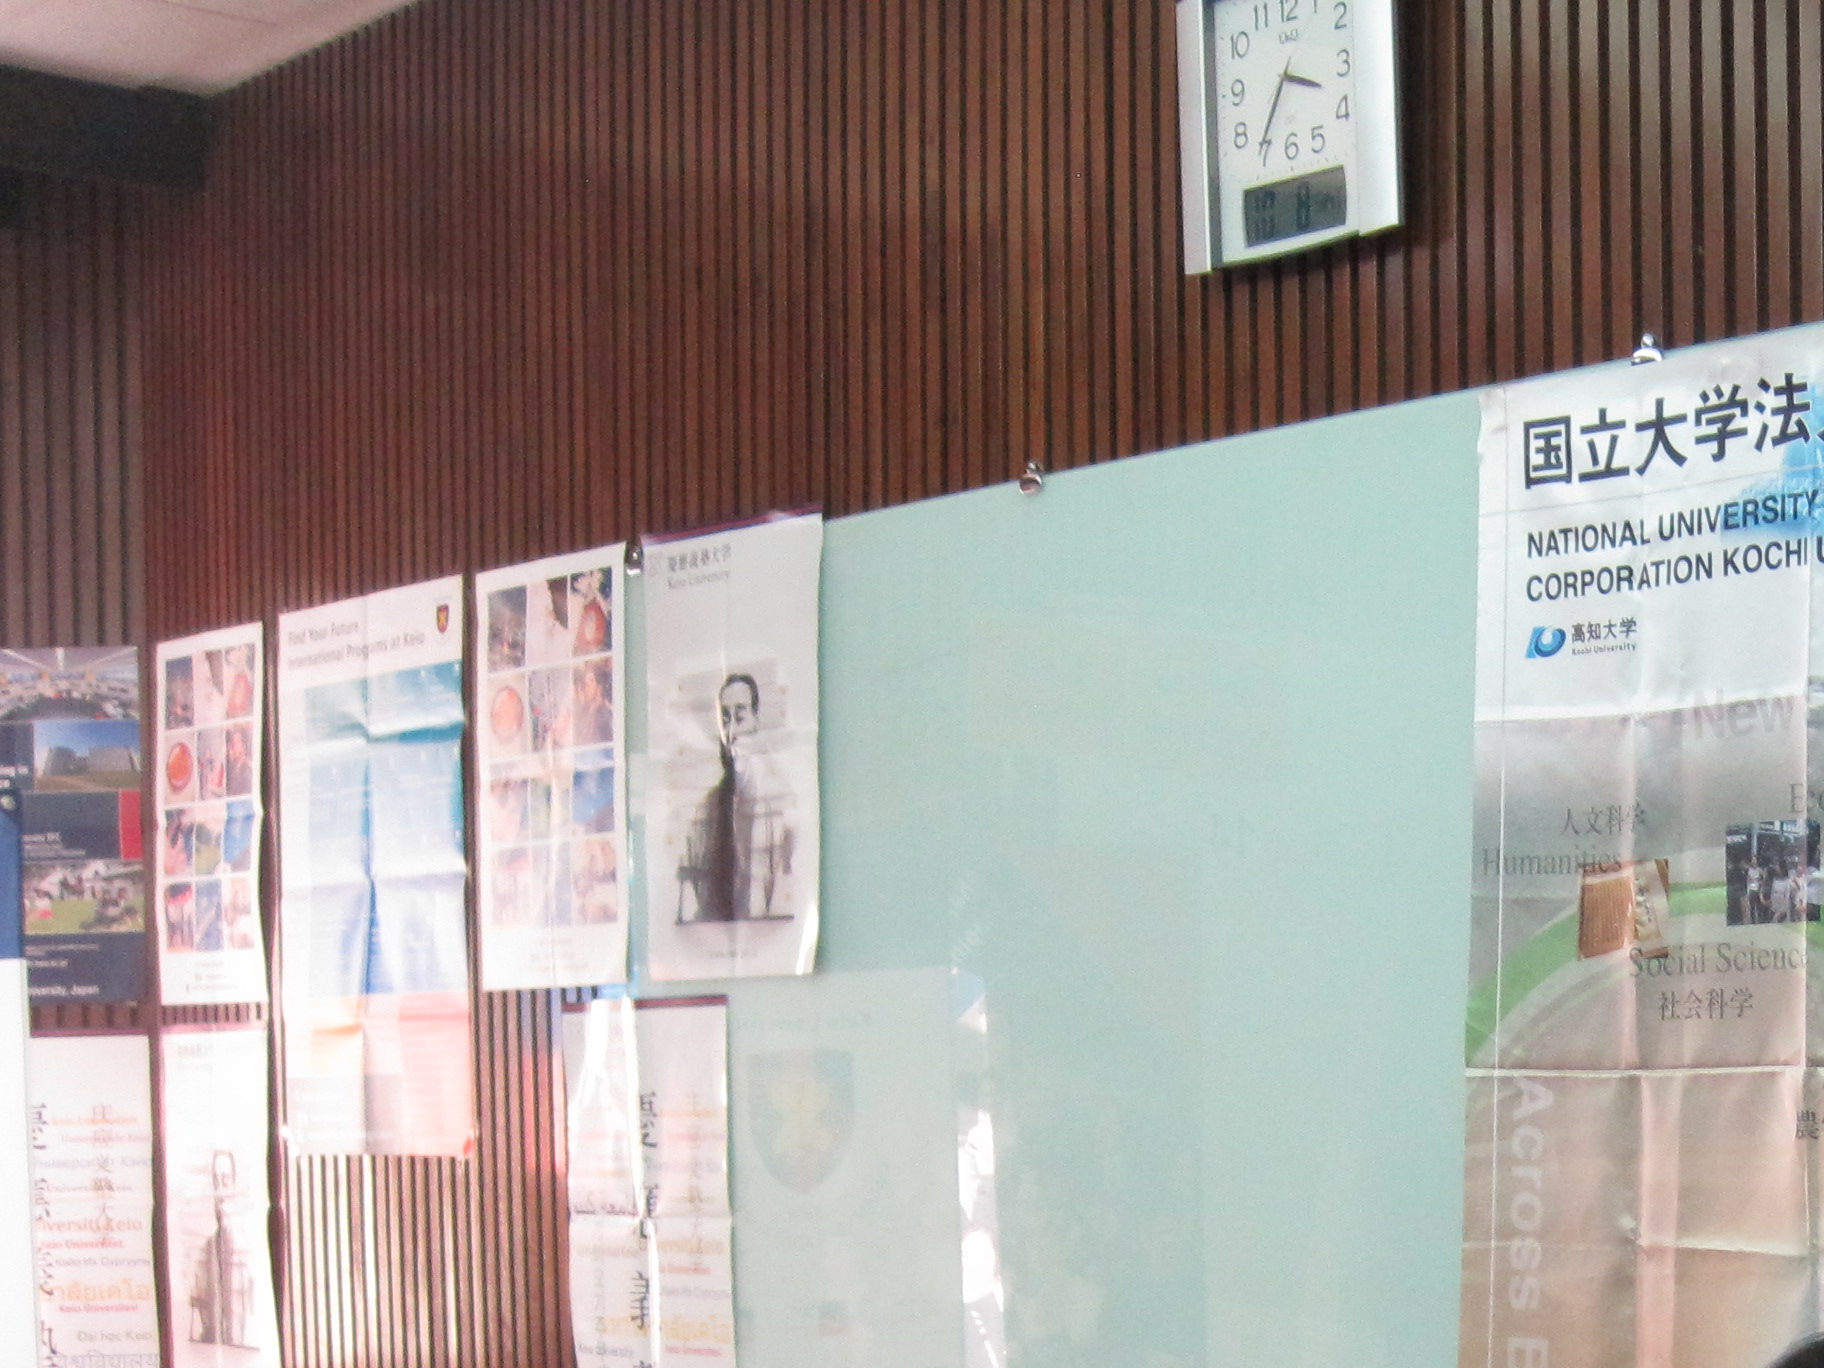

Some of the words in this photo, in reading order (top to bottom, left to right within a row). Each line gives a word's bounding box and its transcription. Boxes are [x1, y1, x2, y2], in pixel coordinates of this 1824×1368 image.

[1253, 3, 1269, 31] 11
[1279, 0, 1298, 23] 12
[1333, 1, 1348, 31] 2
[1230, 31, 1250, 60] 10
[1336, 49, 1351, 78] 3
[1230, 78, 1246, 107] 9
[1335, 94, 1351, 122] 4
[1233, 121, 1249, 149] 8
[1284, 132, 1300, 161] 6
[1310, 125, 1326, 154] 5
[1258, 139, 1273, 168] 7
[1527, 517, 1651, 559] NATIONAL
[1659, 488, 1820, 542] UNIVERSITY
[1526, 551, 1714, 602] CORPORATION
[1723, 540, 1809, 577] KOCHI
[1571, 617, 1638, 644] 高知大学
[1629, 941, 1706, 979] Social
[1507, 1076, 1554, 1311] Across
